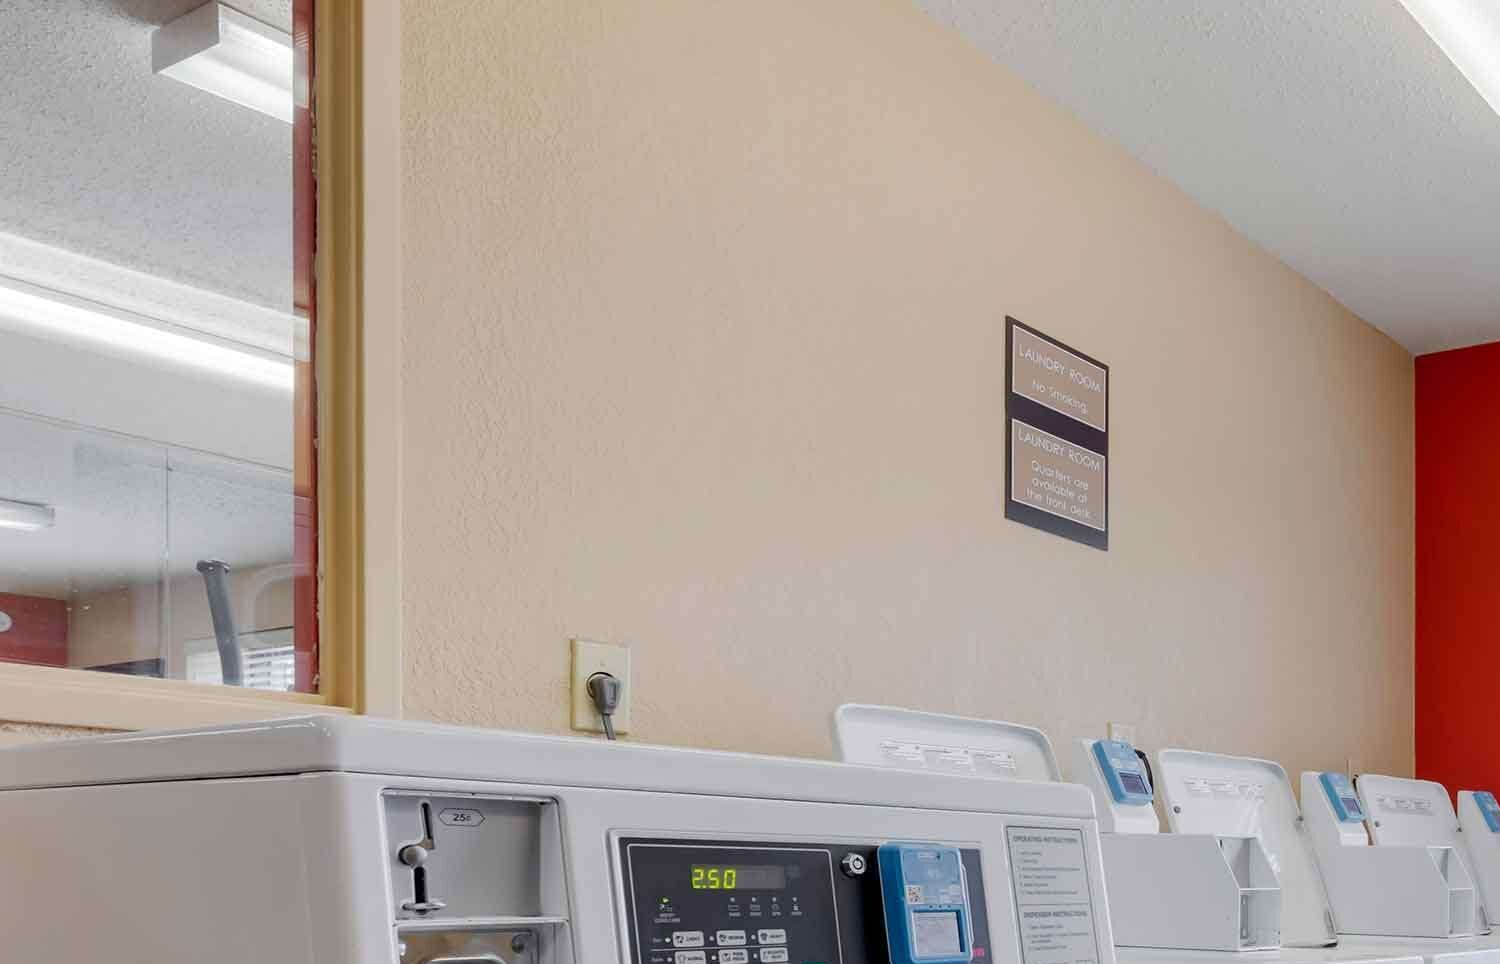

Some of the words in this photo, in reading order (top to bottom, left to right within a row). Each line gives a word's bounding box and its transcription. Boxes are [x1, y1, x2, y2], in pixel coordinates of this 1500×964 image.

[1018, 344, 1065, 375] LAUNDRY
[1069, 368, 1101, 393] ROOM
[1032, 380, 1045, 393] No
[1018, 427, 1064, 456] LAUNDRY
[1069, 451, 1100, 473] ROOM
[1031, 459, 1071, 484] Quarters
[1074, 478, 1088, 490] are
[1026, 487, 1042, 501] the
[1046, 493, 1066, 512] front
[1031, 478, 1074, 499] available
[692, 868, 737, 889] 2.50
